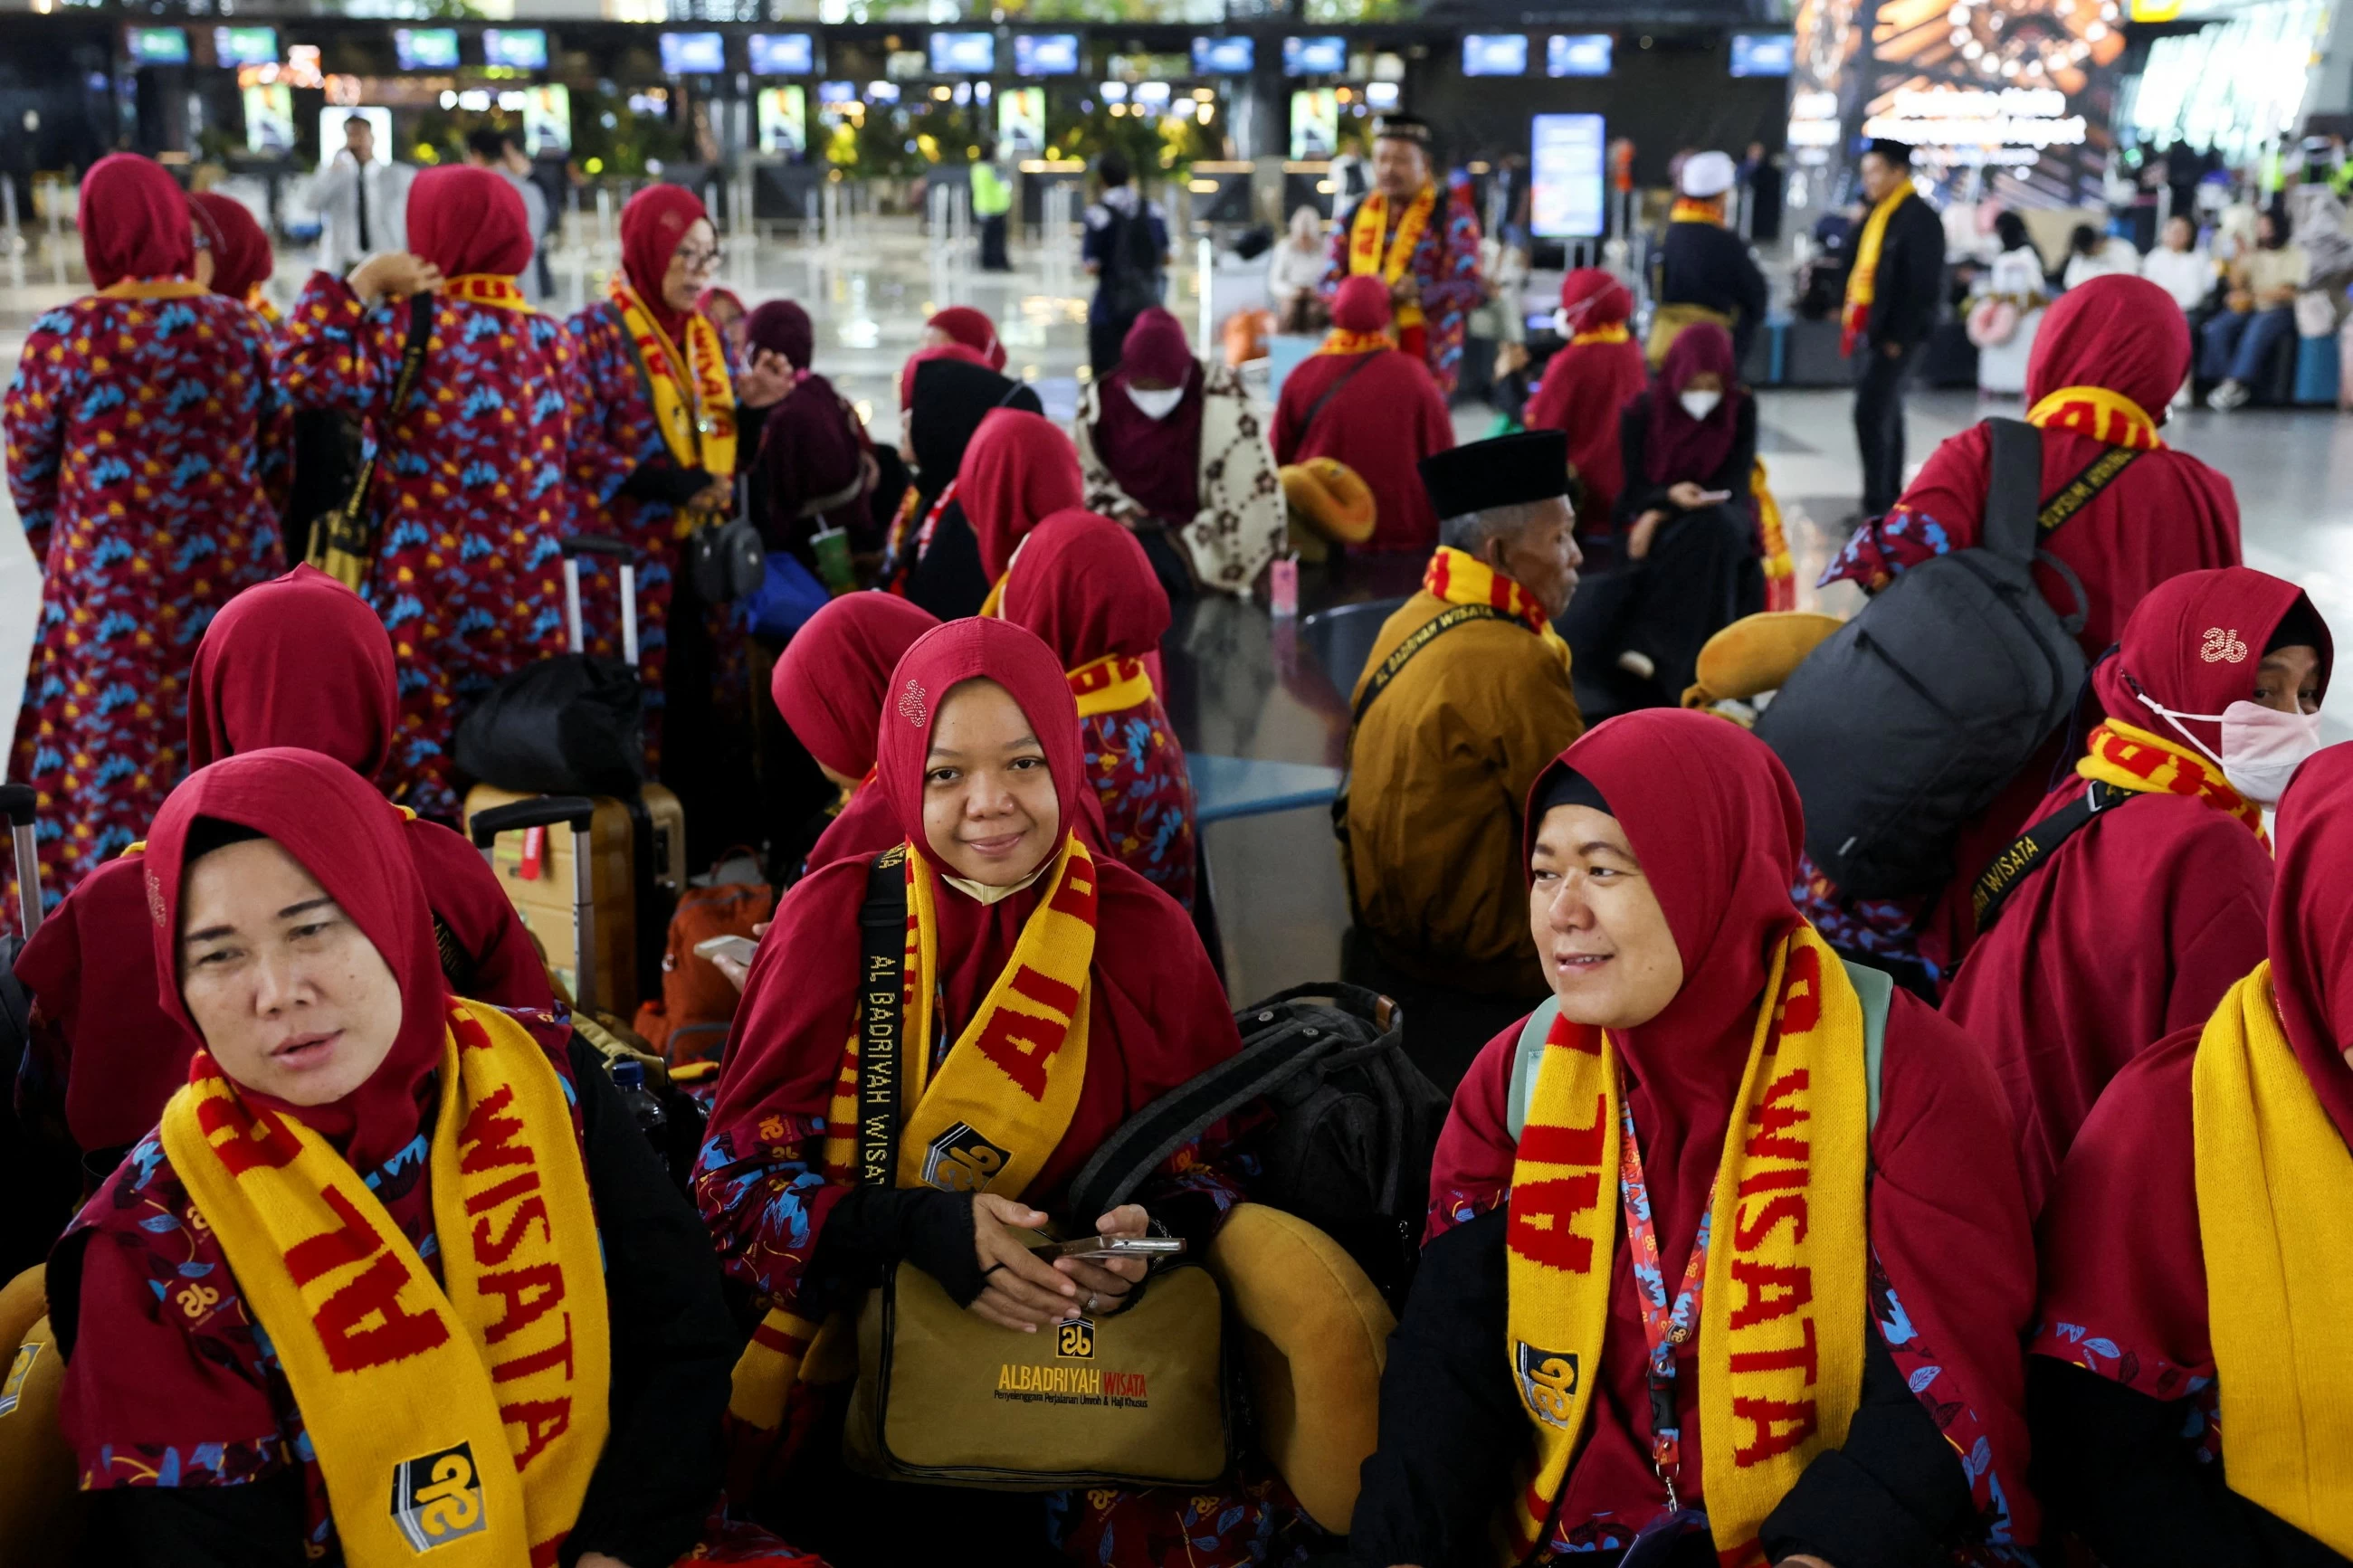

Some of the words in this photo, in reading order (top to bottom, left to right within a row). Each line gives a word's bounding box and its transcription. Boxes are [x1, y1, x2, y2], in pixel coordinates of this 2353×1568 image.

[1982, 835, 2039, 894] WISATA
[869, 955, 895, 983] AL
[866, 992, 896, 1104] BADRIYAH
[864, 1113, 891, 1185] WISAT
[1506, 1092, 1607, 1275] AL
[284, 1184, 451, 1373] AL
[457, 1082, 576, 1472] WISATA
[1729, 1069, 1818, 1468] WISATA
[998, 1364, 1100, 1394] ALBADRIYAH
[1103, 1372, 1147, 1397] WISATA
[1044, 1393, 1079, 1405] Perjalanan
[1080, 1395, 1101, 1406] Umroh
[1110, 1396, 1124, 1409] Haji
[1124, 1397, 1148, 1408] Khusus
